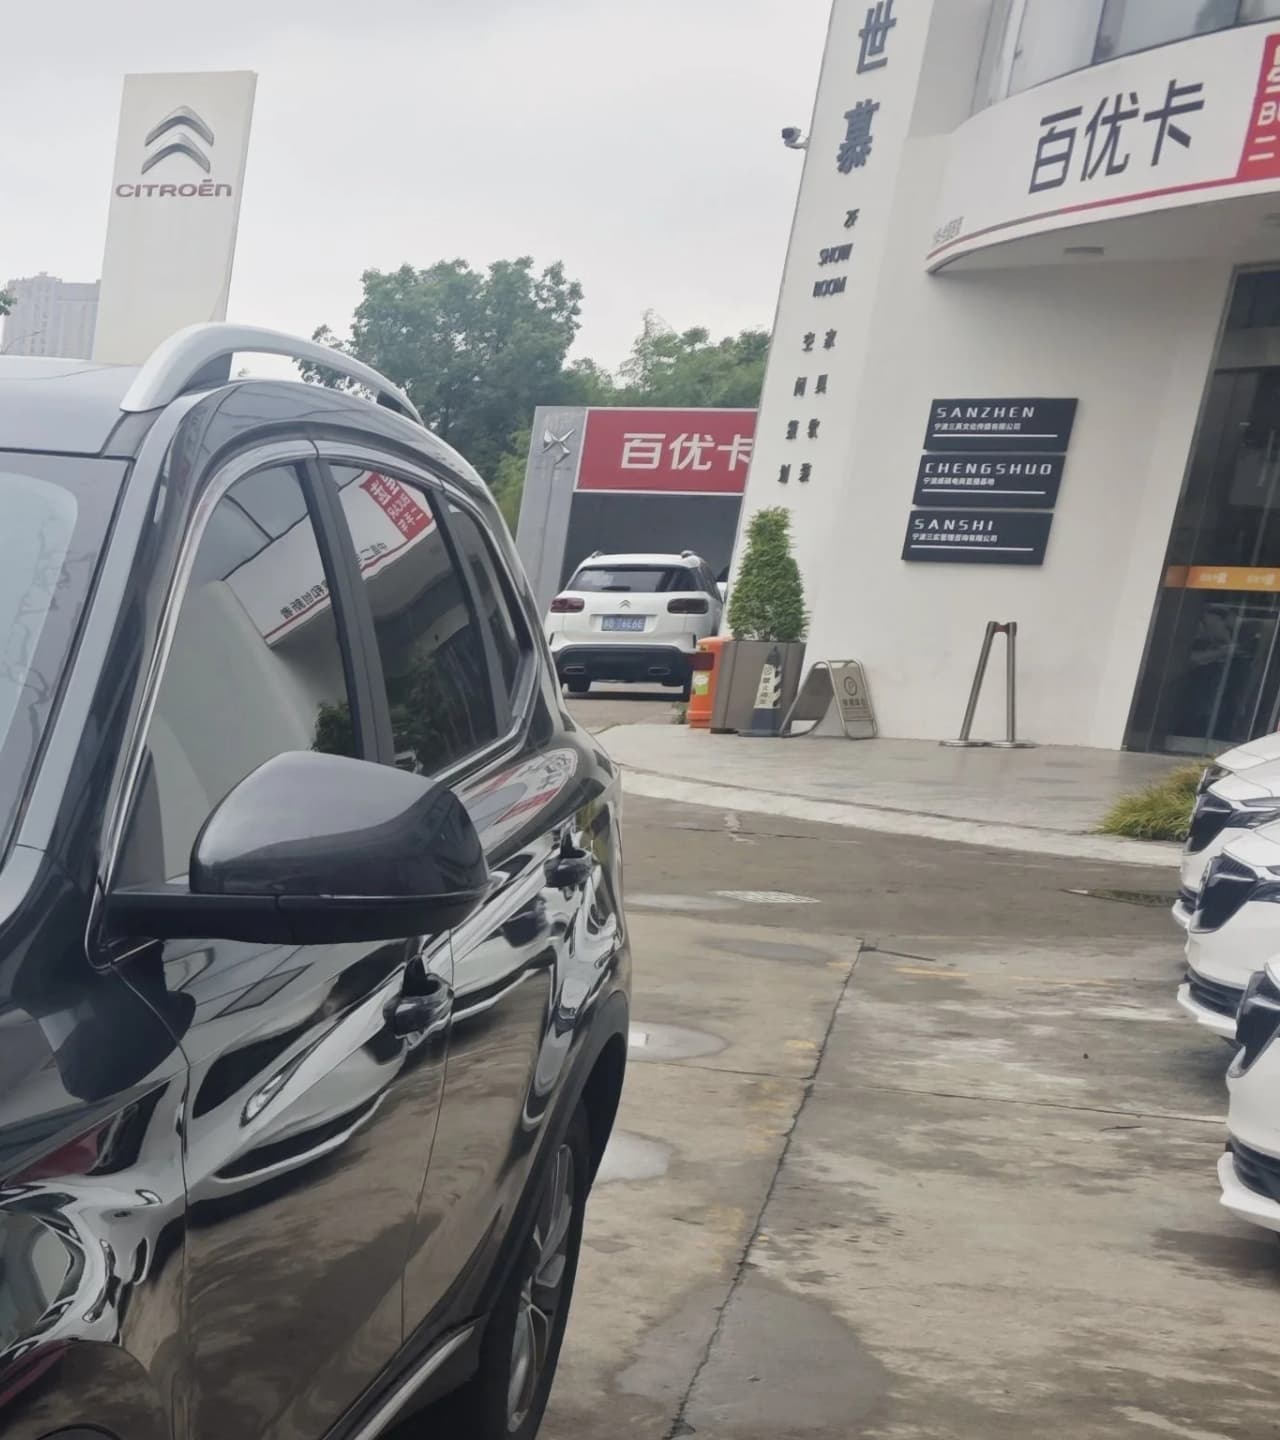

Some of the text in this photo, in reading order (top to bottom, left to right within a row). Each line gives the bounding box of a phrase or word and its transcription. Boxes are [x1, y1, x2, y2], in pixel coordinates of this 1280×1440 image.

[1028, 79, 1205, 194] 百优卡
[818, 242, 853, 267] SHOW
[936, 406, 1035, 419] SANZHEN
[924, 462, 1053, 476] CHENGSHUO
[913, 518, 994, 532] SANSHI
